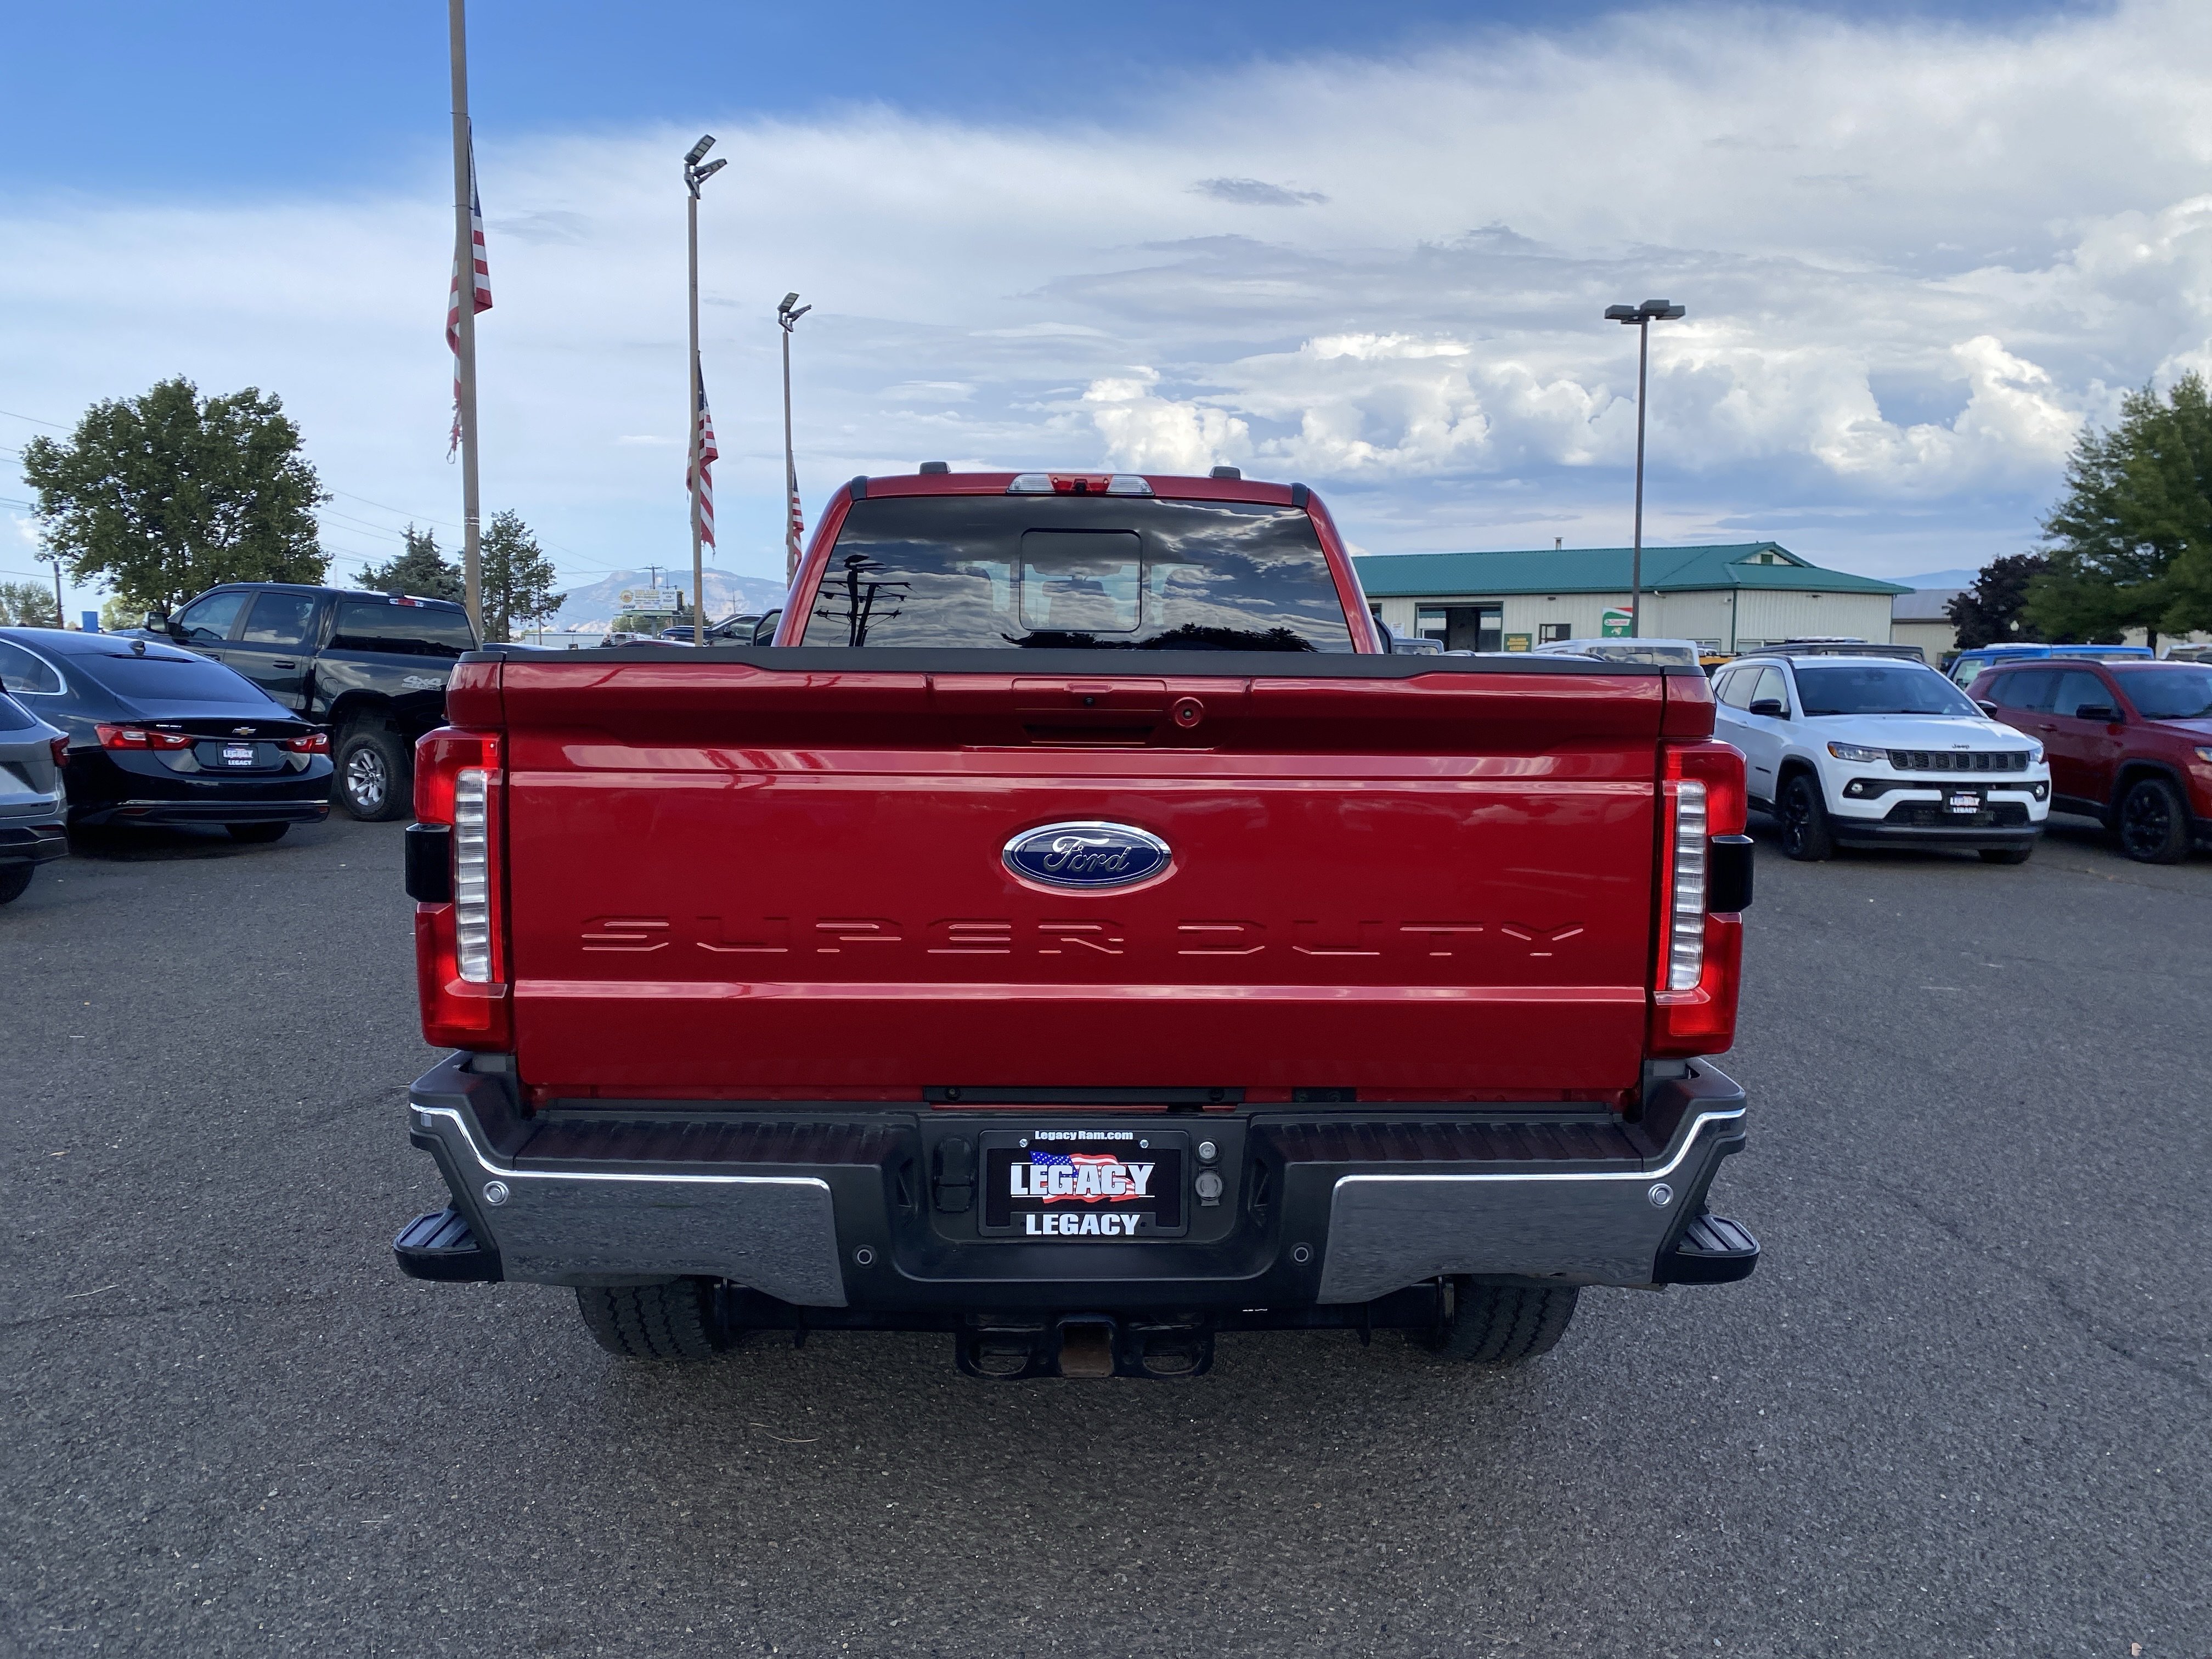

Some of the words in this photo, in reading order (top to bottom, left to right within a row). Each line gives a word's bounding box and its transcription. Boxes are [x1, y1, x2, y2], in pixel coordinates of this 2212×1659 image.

[1043, 836, 1132, 872] Ford
[582, 915, 1124, 954] SUPER
[1177, 918, 1584, 956] DUTY
[1011, 1164, 1154, 1195] LEGACY
[1026, 1214, 1141, 1235] LEGACY
